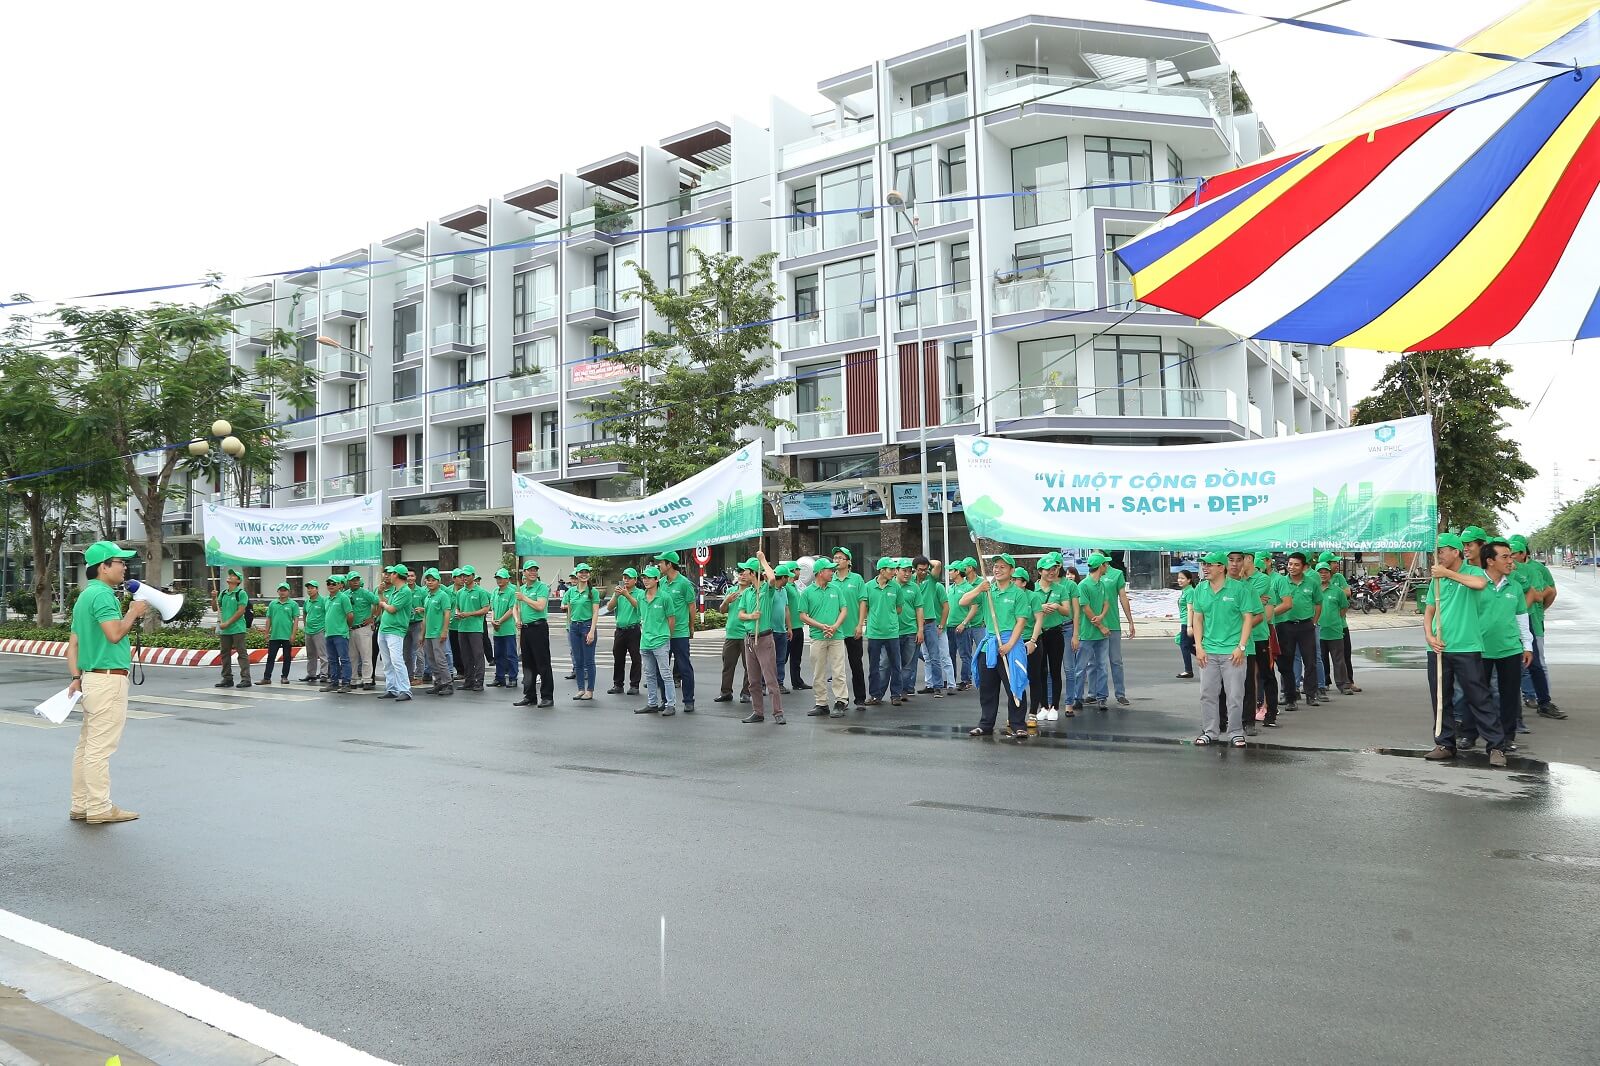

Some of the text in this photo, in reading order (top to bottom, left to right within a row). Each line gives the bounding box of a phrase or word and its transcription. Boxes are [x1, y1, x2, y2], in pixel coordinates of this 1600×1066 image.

[1072, 471, 1123, 491] MỘT
[1129, 471, 1197, 492] CỘNG
[1205, 467, 1276, 488] ĐỒNG
[1042, 496, 1101, 513] XANH
[1121, 496, 1185, 516] SẠCH
[1207, 494, 1269, 516] ĐẸP”
[570, 519, 604, 532] XANH
[611, 523, 649, 536] SẠCH
[237, 535, 264, 546] XANH
[270, 535, 295, 547] SẠCH
[697, 546, 707, 558] 30
